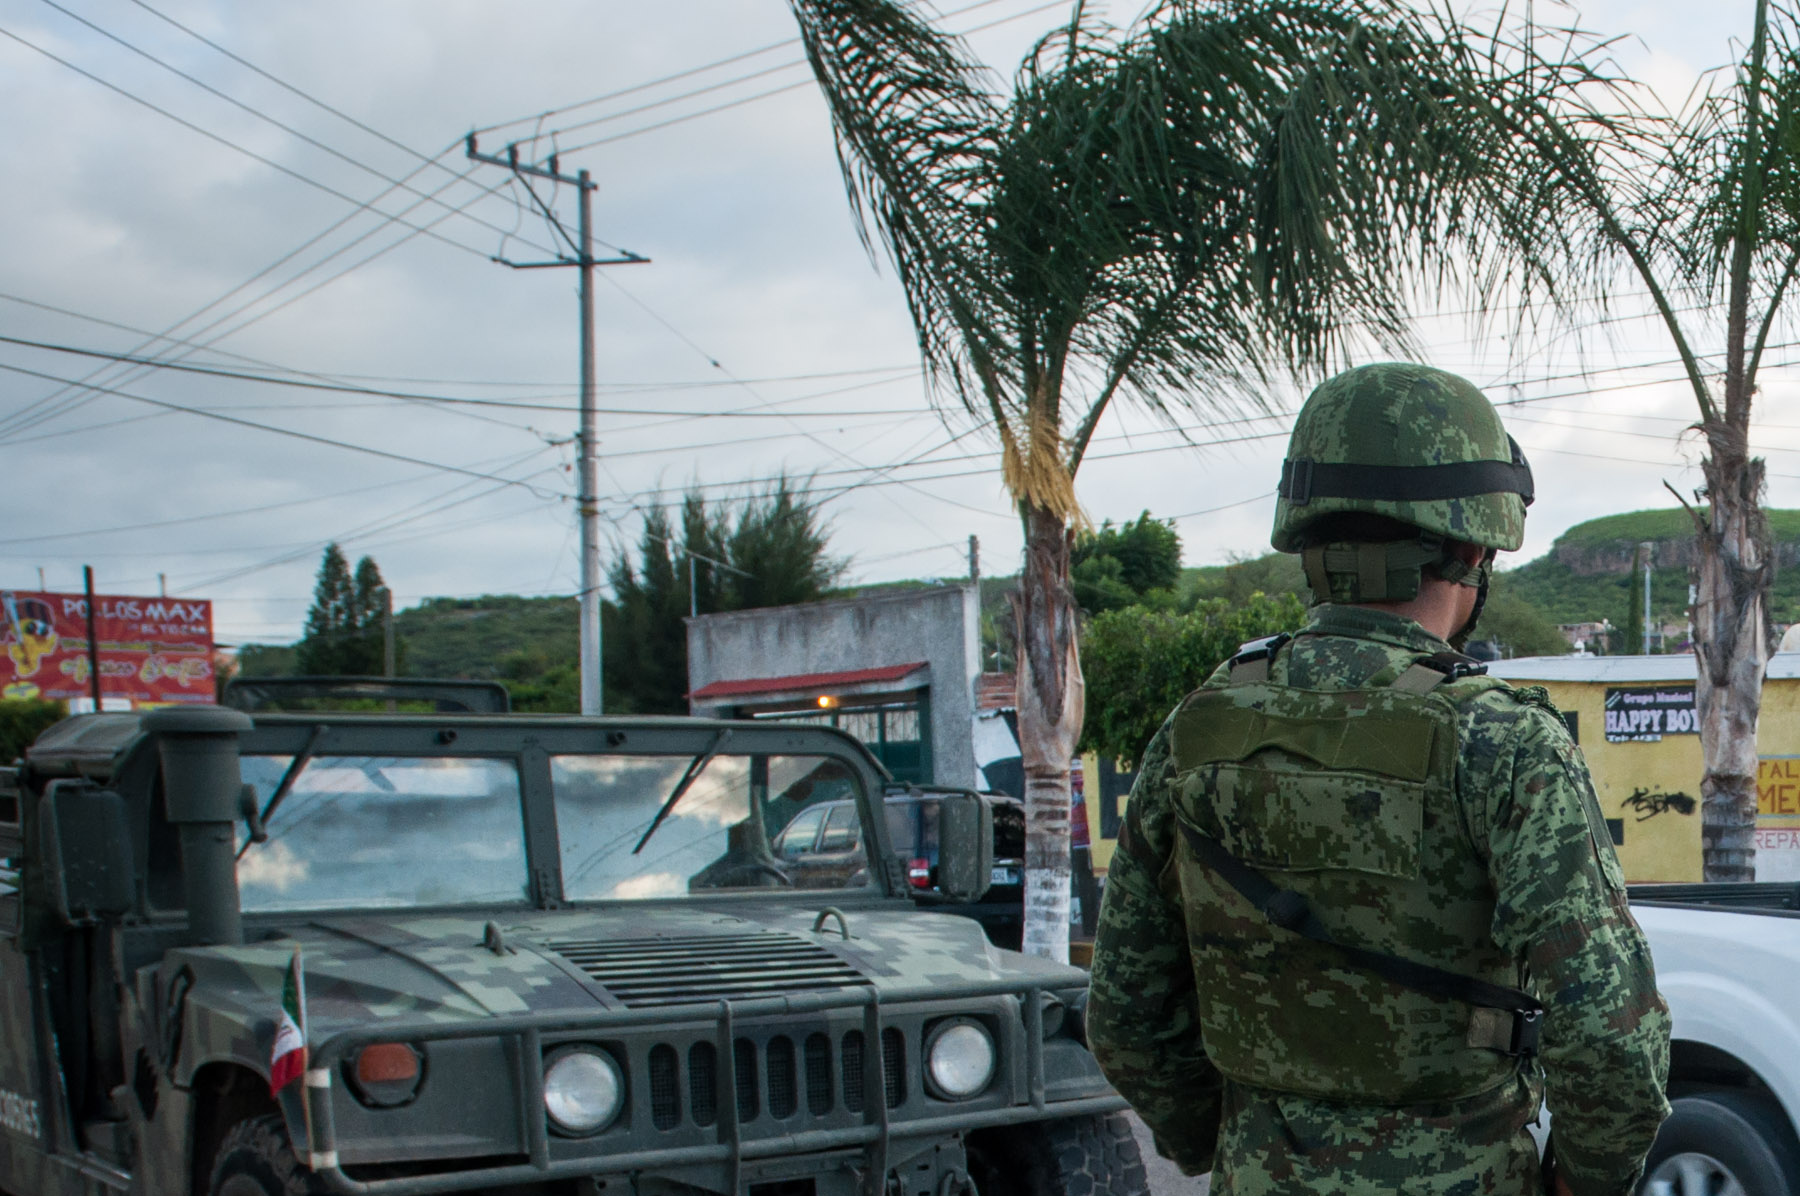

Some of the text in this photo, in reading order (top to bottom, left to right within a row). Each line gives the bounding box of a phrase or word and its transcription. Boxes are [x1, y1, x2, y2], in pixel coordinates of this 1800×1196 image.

[62, 599, 206, 622] POLOS MAX
[1623, 692, 1693, 705] Grupo Musical
[1605, 710, 1662, 732] HAPPY
